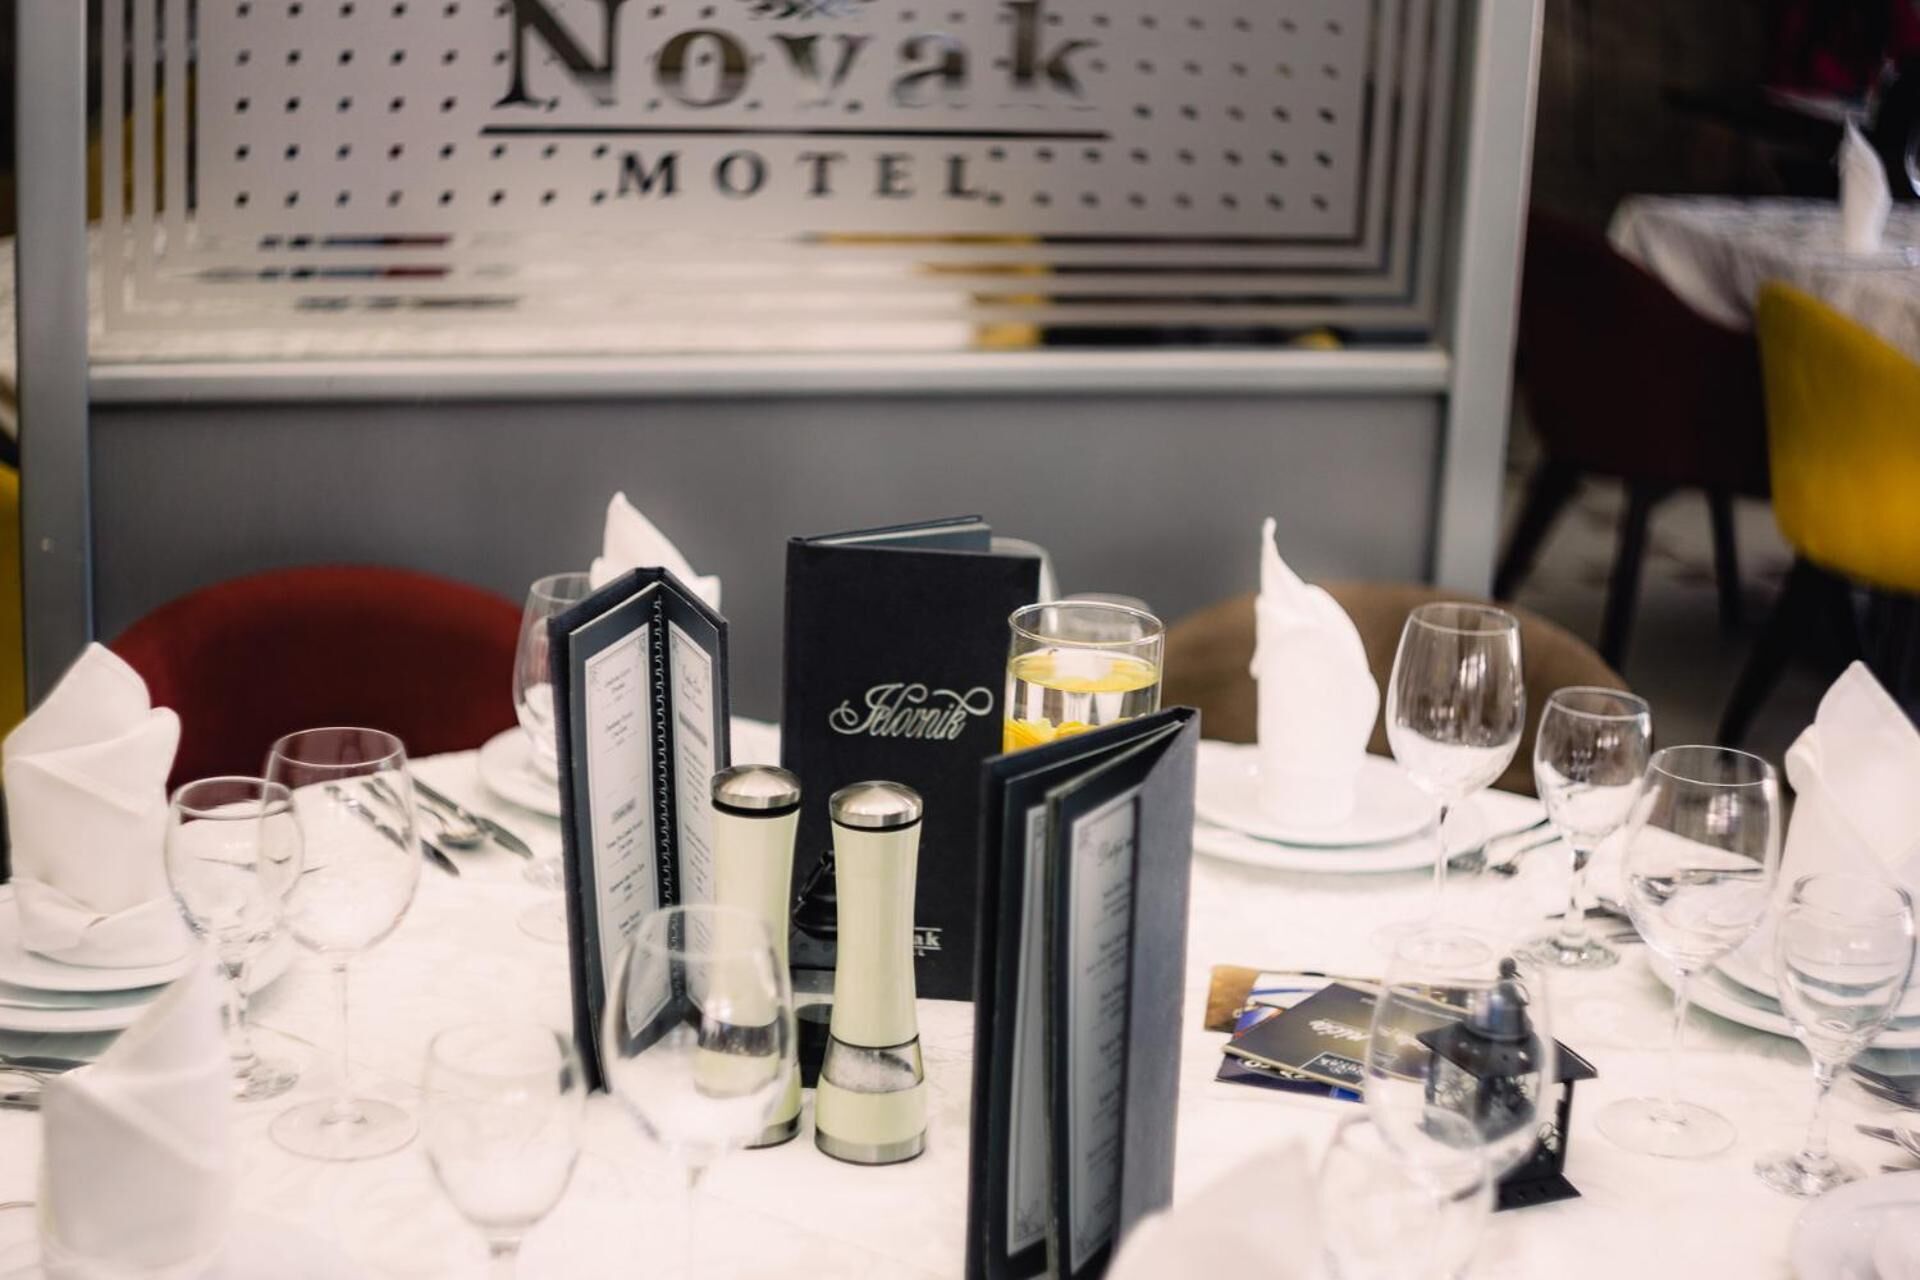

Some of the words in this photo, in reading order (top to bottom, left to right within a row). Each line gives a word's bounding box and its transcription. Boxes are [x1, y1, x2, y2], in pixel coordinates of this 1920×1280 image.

[493, 0, 1100, 109] Novak
[615, 150, 986, 199] MOTEL
[829, 682, 994, 740] Jelovnik
